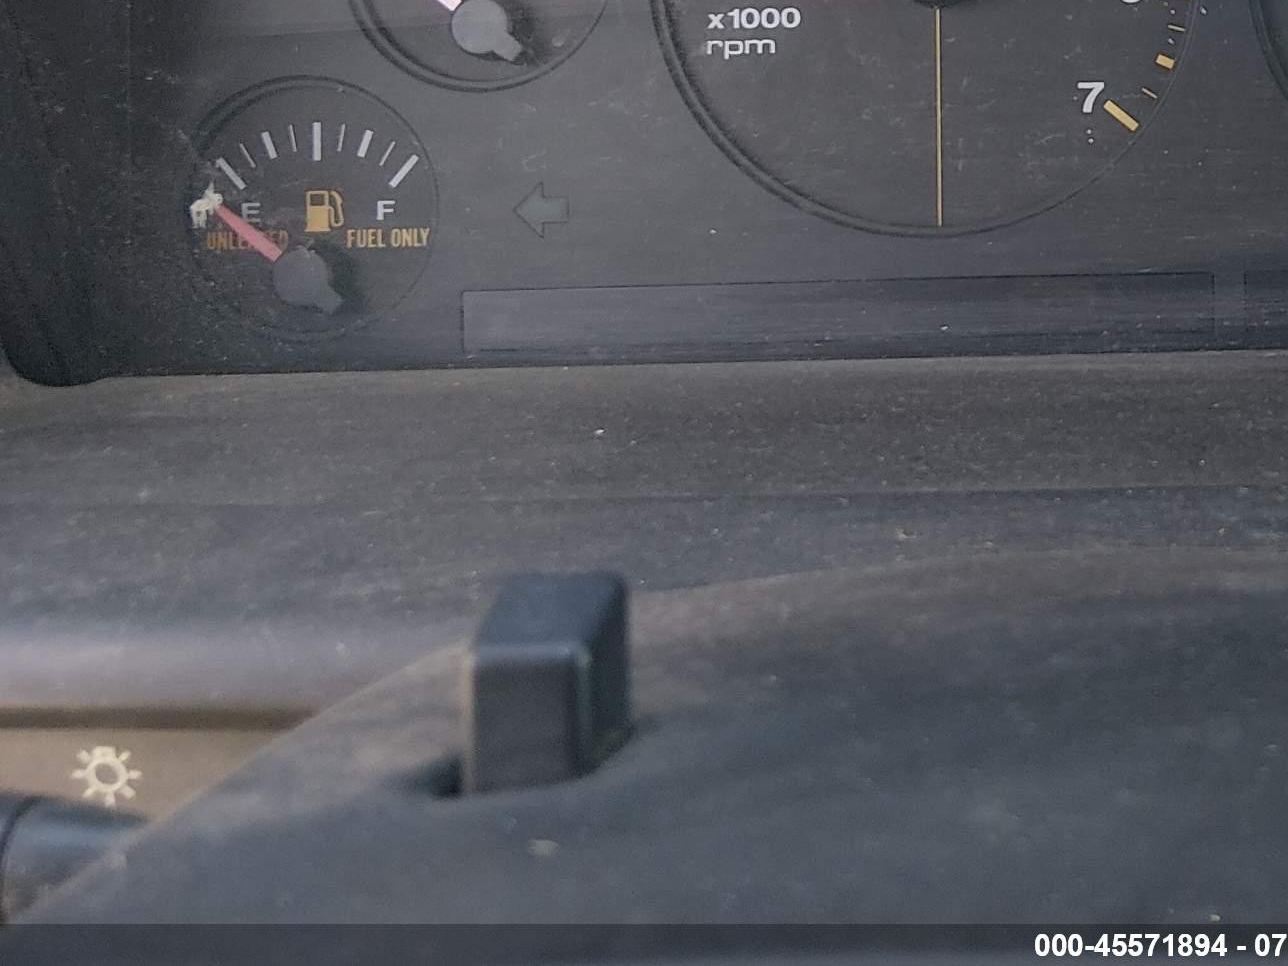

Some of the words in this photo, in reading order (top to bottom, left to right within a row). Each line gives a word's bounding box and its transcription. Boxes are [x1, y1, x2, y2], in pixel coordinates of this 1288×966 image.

[707, 8, 801, 30] x1000
[706, 38, 777, 59] rpm
[1077, 81, 1105, 113] 7
[241, 202, 261, 224] E
[376, 200, 396, 221] F
[207, 229, 289, 251] UNLED
[347, 229, 386, 248] FUEL
[390, 228, 431, 247] ONLY
